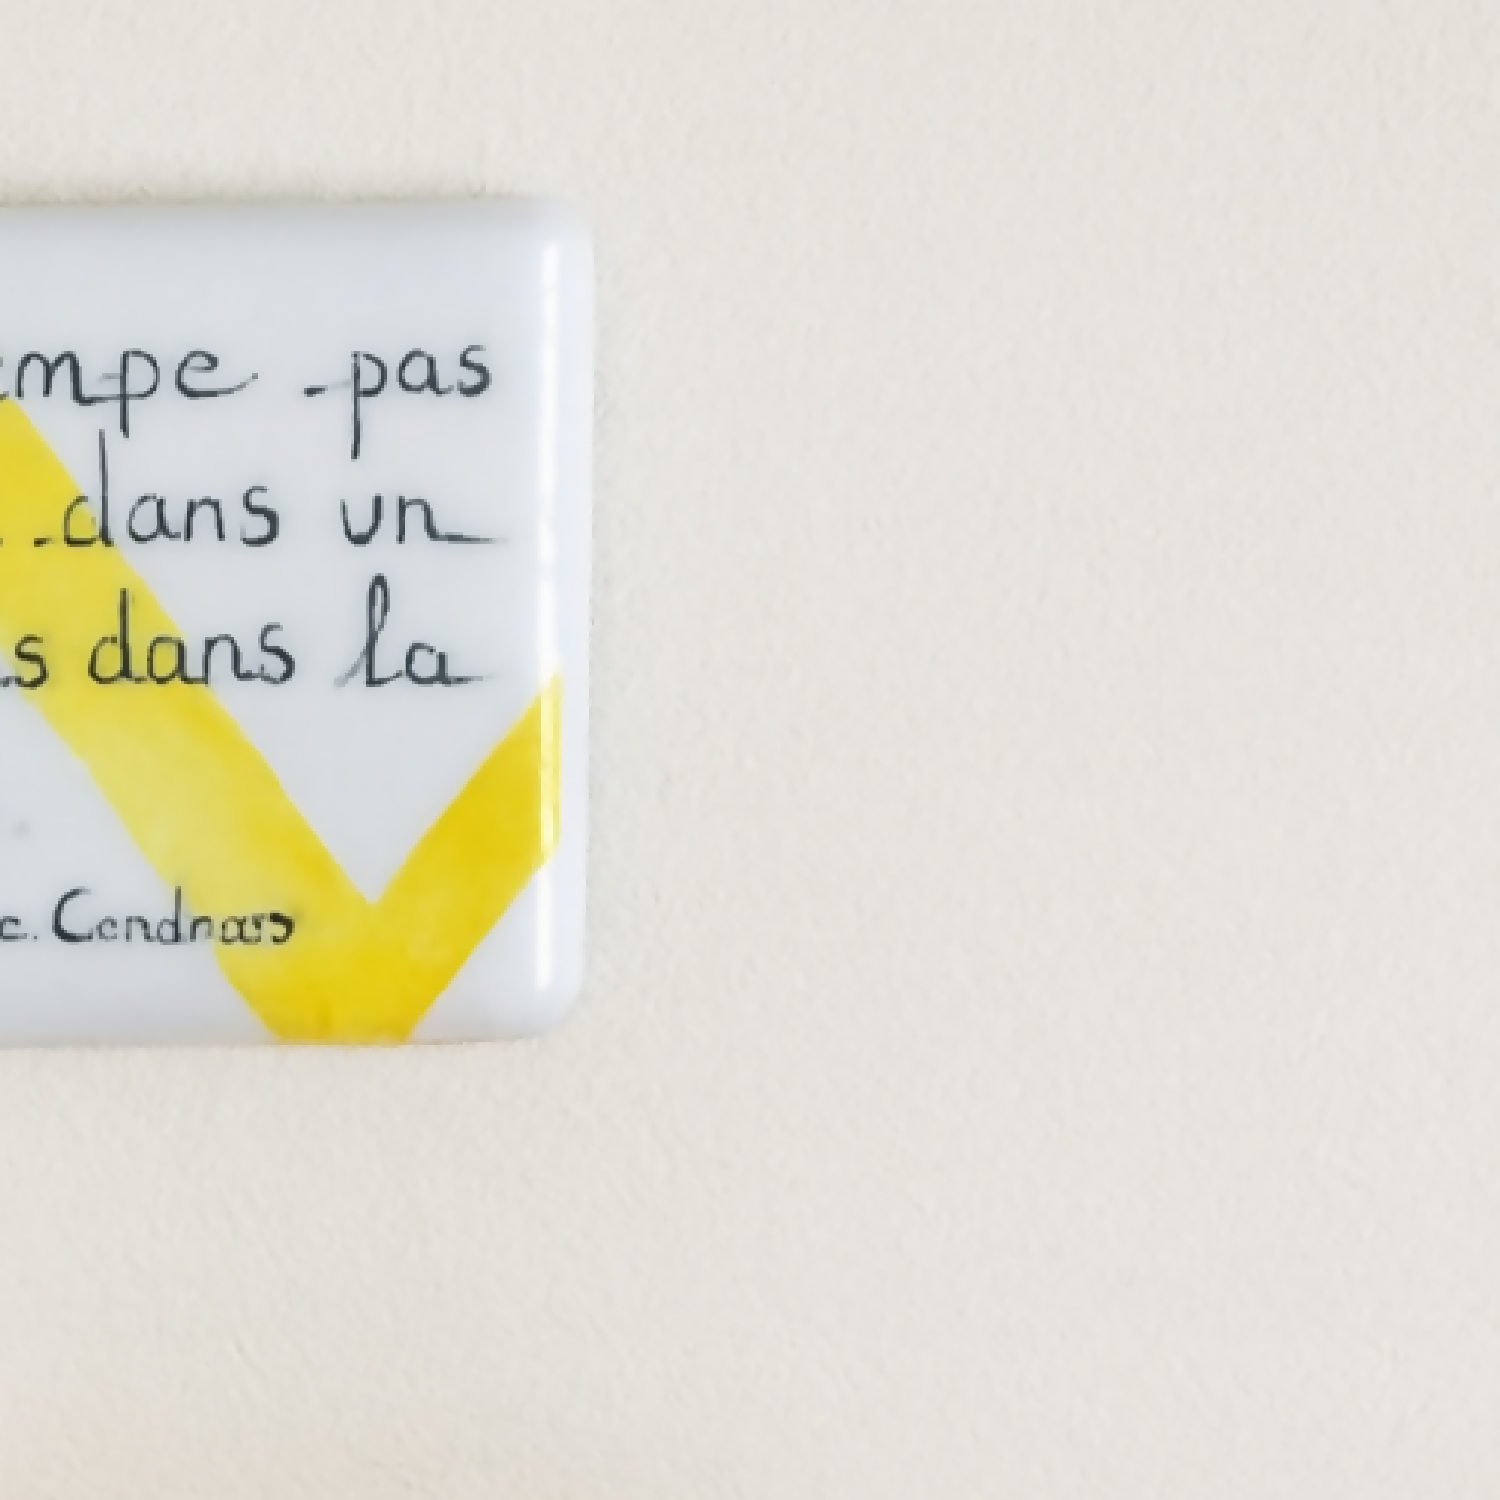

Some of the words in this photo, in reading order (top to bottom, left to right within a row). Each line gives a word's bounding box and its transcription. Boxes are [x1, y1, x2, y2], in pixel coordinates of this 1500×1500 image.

[341, 494, 500, 546] un
[86, 586, 298, 687] dans
[335, 571, 485, 689] la
